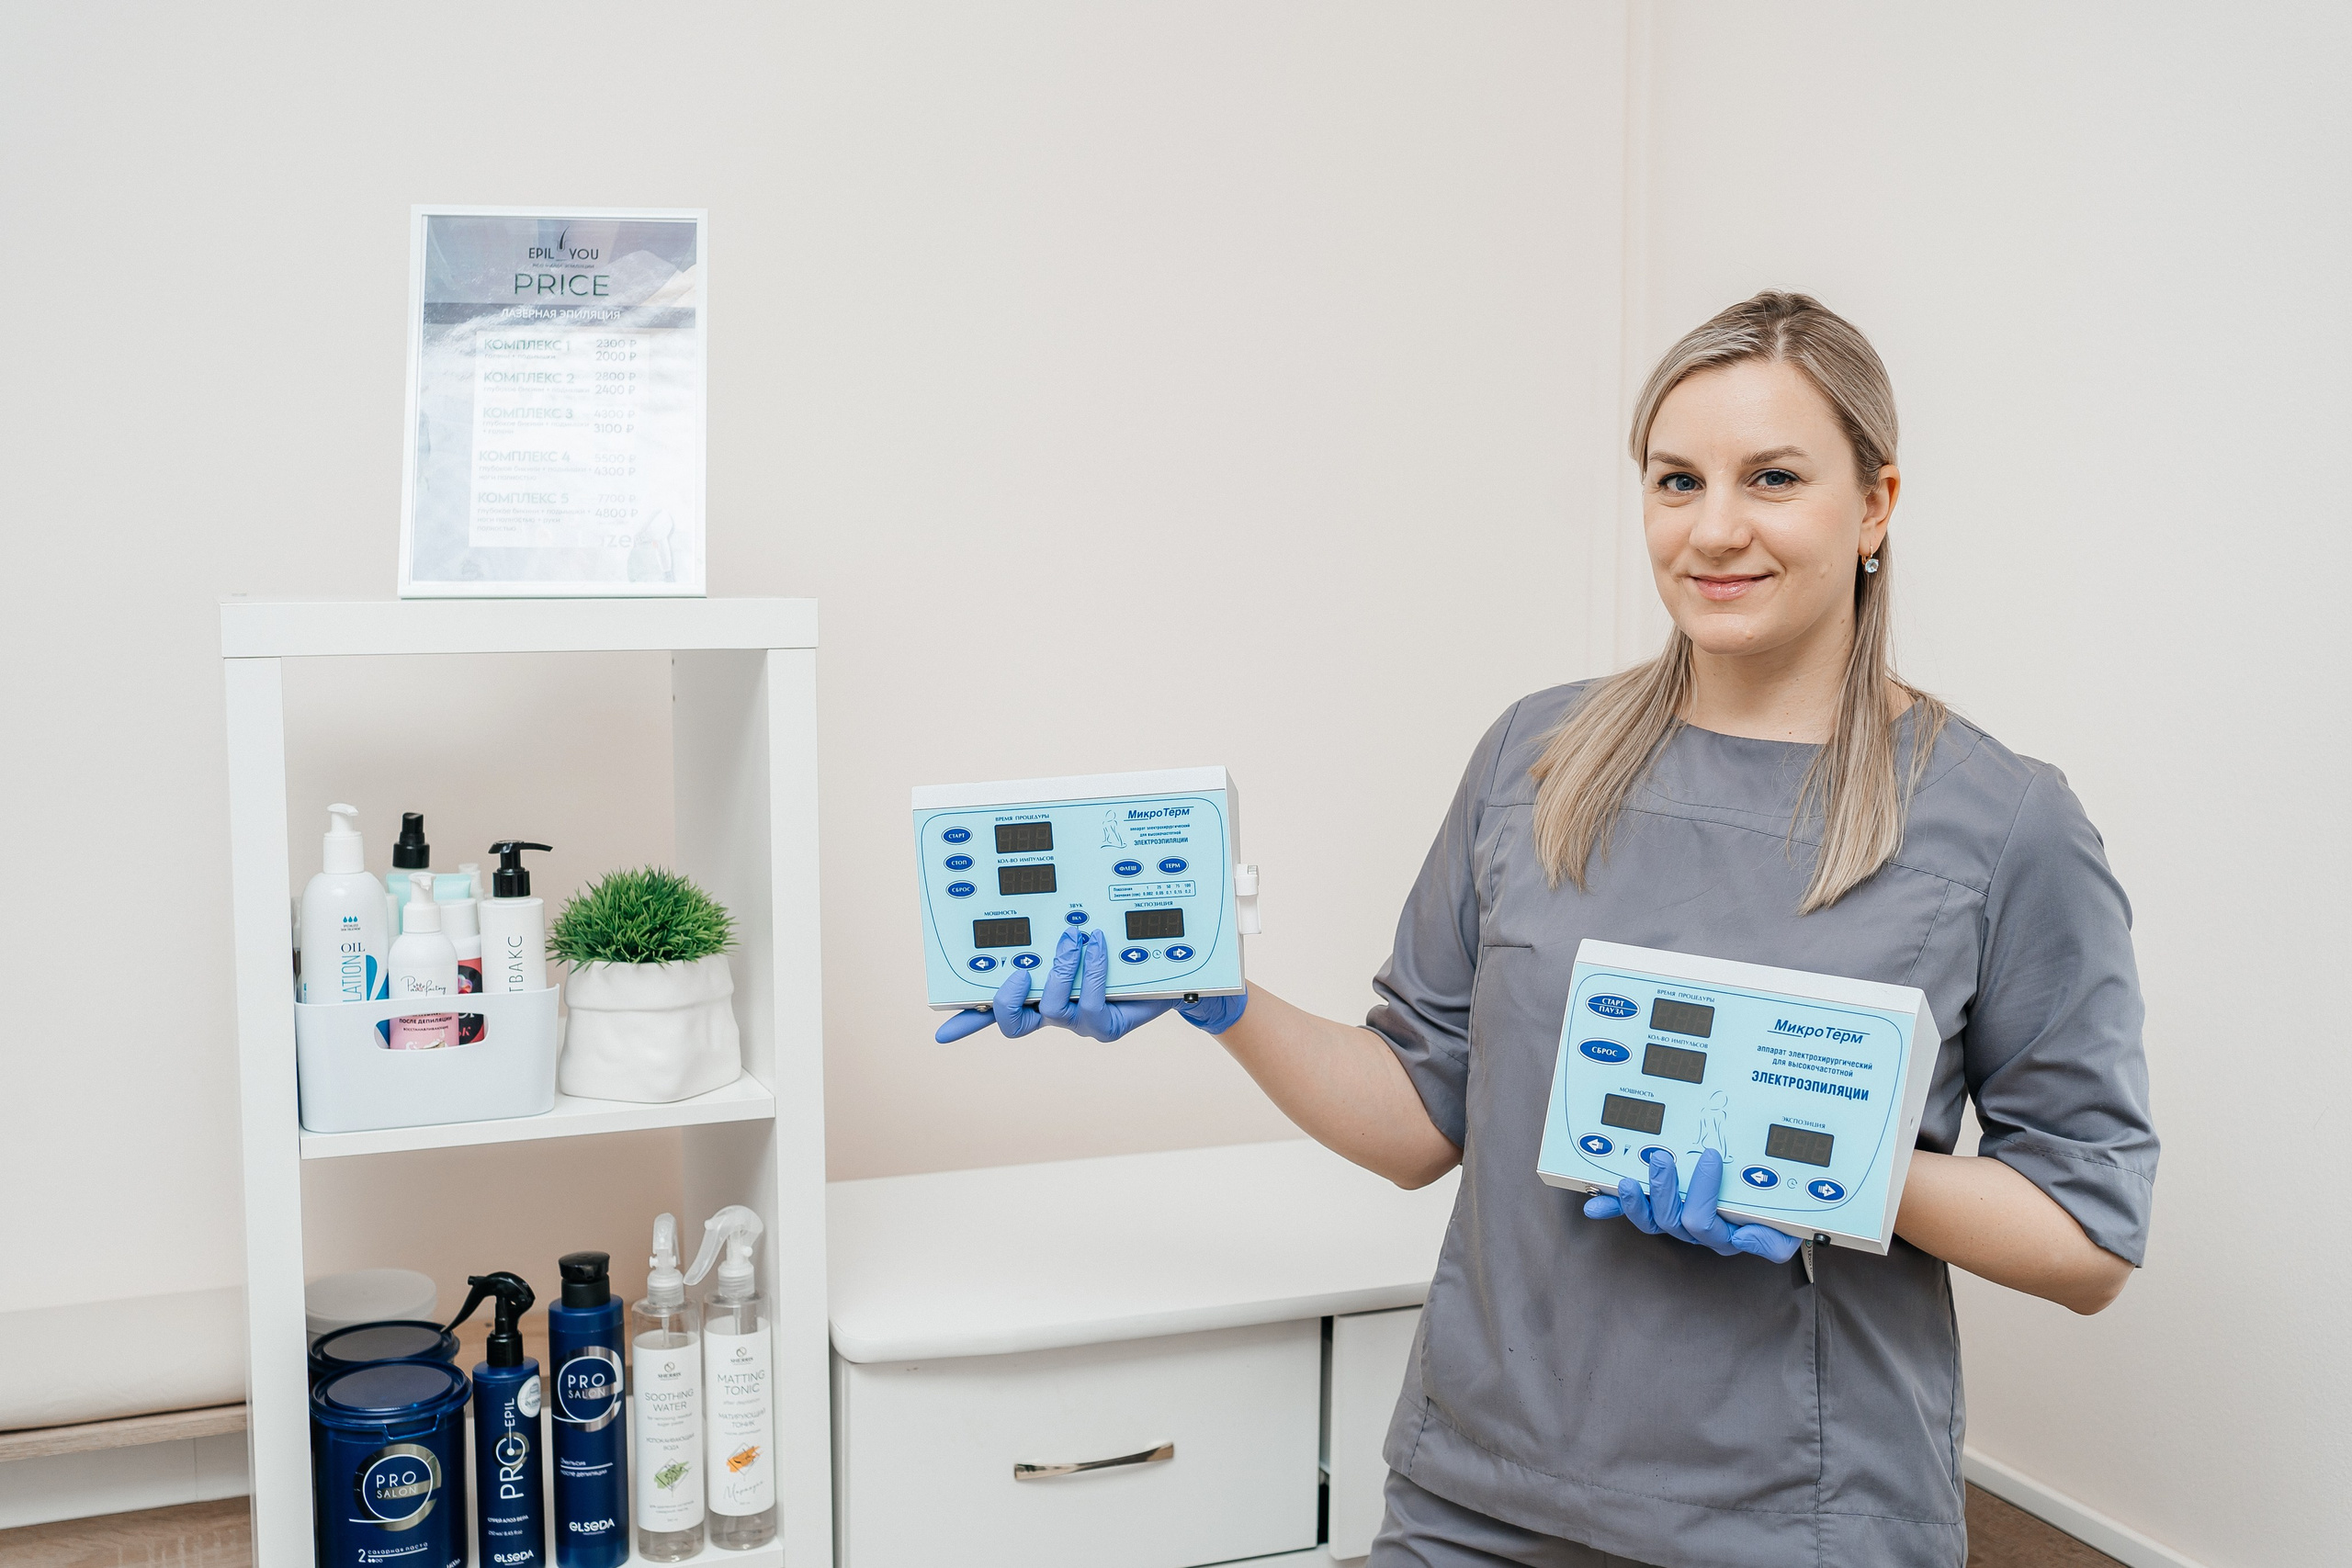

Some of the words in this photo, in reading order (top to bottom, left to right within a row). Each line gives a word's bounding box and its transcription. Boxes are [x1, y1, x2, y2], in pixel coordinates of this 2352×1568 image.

[528, 247, 554, 259] EPIL
[570, 248, 599, 260] YOU
[514, 273, 609, 296] PRICE
[501, 308, 557, 319] ЛАЗЕРНАЯ
[560, 310, 622, 321] ЭПИЛЯЦИЯ
[484, 339, 561, 351] КОМПЛЕКС
[566, 341, 571, 352] 1
[596, 339, 625, 348] 2300
[595, 352, 626, 361] 2000
[484, 371, 562, 383] КОМПЛЕКС
[567, 373, 574, 384] 2
[595, 371, 625, 381] 2800
[595, 385, 625, 395] 2400
[483, 407, 561, 419] КОМПЛЕКС
[565, 408, 573, 419] 3
[594, 410, 624, 419] 4300
[594, 423, 622, 434] 3100
[479, 450, 558, 462] КОМПЛЕКС
[561, 451, 571, 462] 4
[594, 467, 625, 476] 4300
[478, 492, 557, 504] КОМПЛЕКС
[561, 493, 570, 504] 5
[595, 508, 627, 518] 4800
[1127, 807, 1190, 819] МикроТерм
[1134, 837, 1189, 846] ЭЛЕКТРОЭПИЛЯЦИИ
[341, 942, 366, 953] OIL
[1657, 988, 1676, 997] ВРЕМЯ
[1679, 992, 1715, 1003] ПРОЦЕДУРЫ
[1601, 998, 1625, 1007] СТАРТ
[1599, 1006, 1624, 1016] ПАУЗА
[418, 1016, 453, 1024] ДЕПИЛЯЦИИ
[1774, 1019, 1863, 1044] МикроТерм
[1647, 1034, 1669, 1043] КОЛ-ВО
[1671, 1037, 1709, 1049] ИМПУЛЬСОВ
[1591, 1046, 1618, 1057] СБРОС
[1757, 1045, 1786, 1056] аппарат
[1789, 1051, 1872, 1070] электрохирургический
[1772, 1057, 1786, 1066] для
[1788, 1061, 1853, 1077] высокочастотной
[1751, 1070, 1870, 1101] ЭЛЕКТРОЭПИЛЯЦИИ
[1619, 1087, 1655, 1098] МОЩНОСТЬ
[1781, 1115, 1826, 1129] ЭКСПОЗИЦИЯ
[568, 1372, 605, 1389] PRO
[717, 1370, 765, 1384] MATTING
[568, 1388, 606, 1399] SALON
[644, 1388, 694, 1402] SOOTHING
[724, 1382, 760, 1396] TONIC
[503, 1397, 515, 1427] EPIL
[652, 1401, 687, 1412] WATER
[376, 1471, 417, 1488] PRO
[376, 1485, 418, 1499] SALON
[357, 1548, 367, 1562] 2
